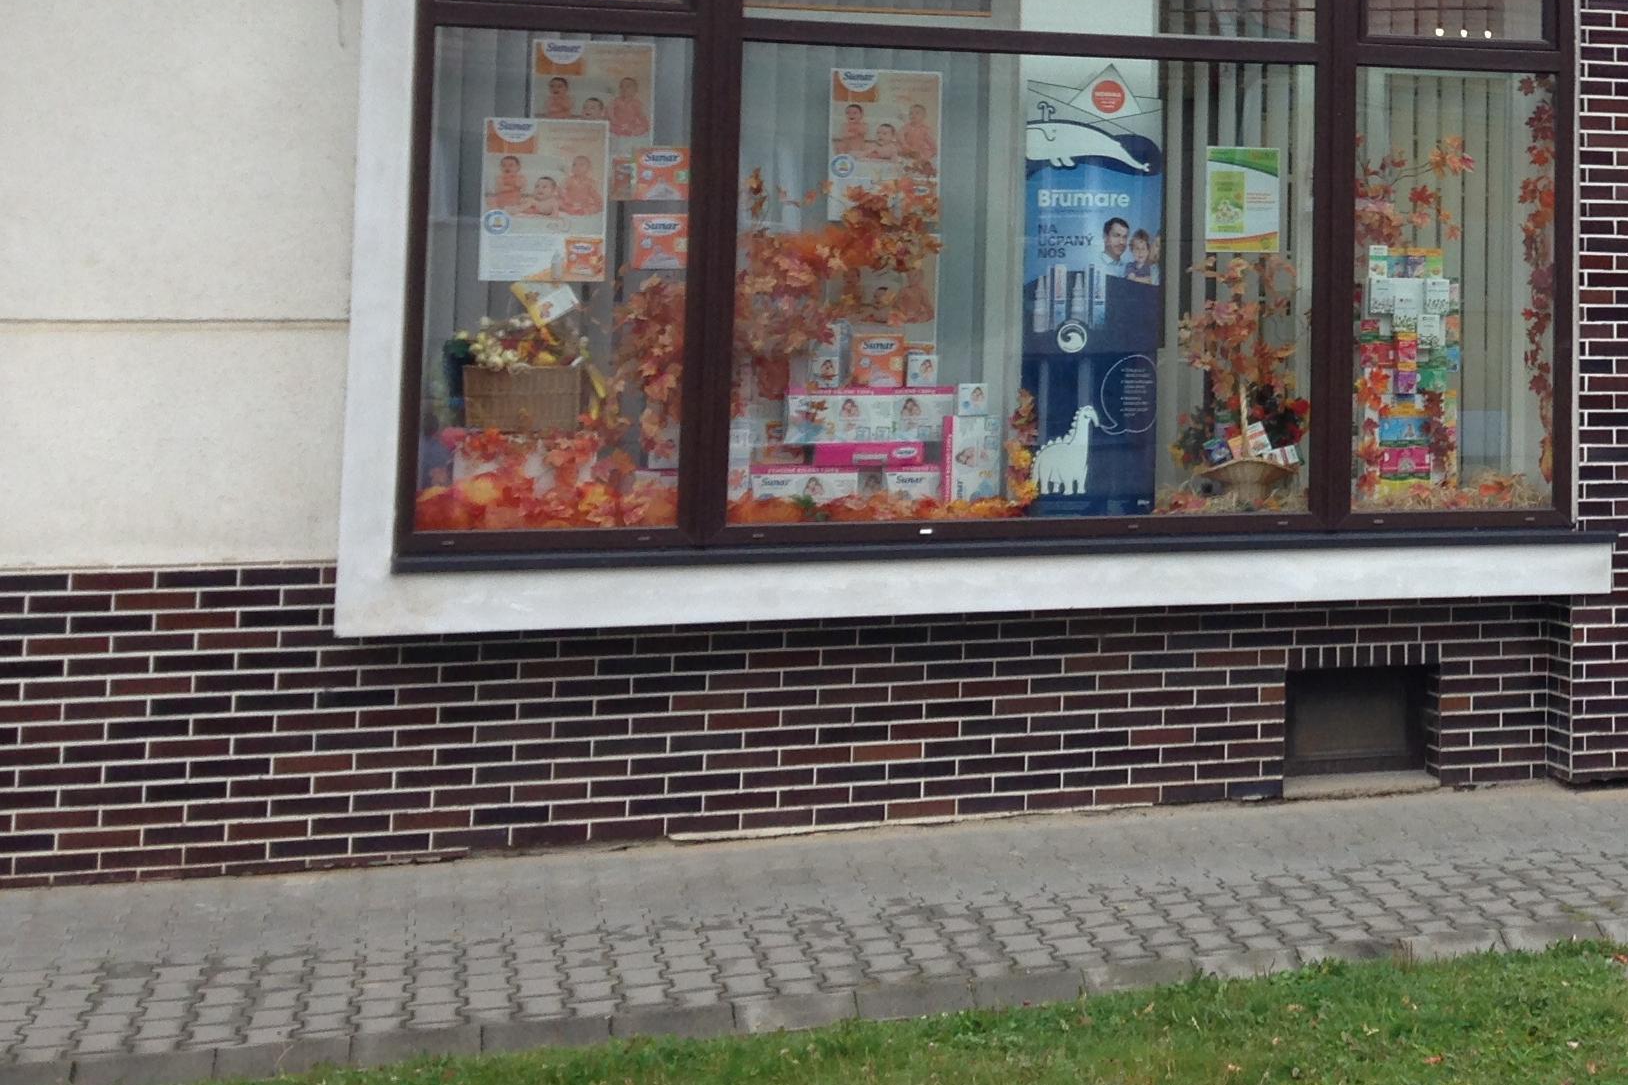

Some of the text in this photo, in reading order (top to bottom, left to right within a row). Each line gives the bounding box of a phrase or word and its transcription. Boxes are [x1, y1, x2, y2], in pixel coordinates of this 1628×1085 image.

[643, 153, 679, 163] Sunar
[1038, 189, 1130, 208] Brumare
[643, 220, 680, 231] Sunar
[862, 341, 895, 350] Sunar
[761, 477, 791, 487] Sunar
[896, 474, 926, 485] Sunar
